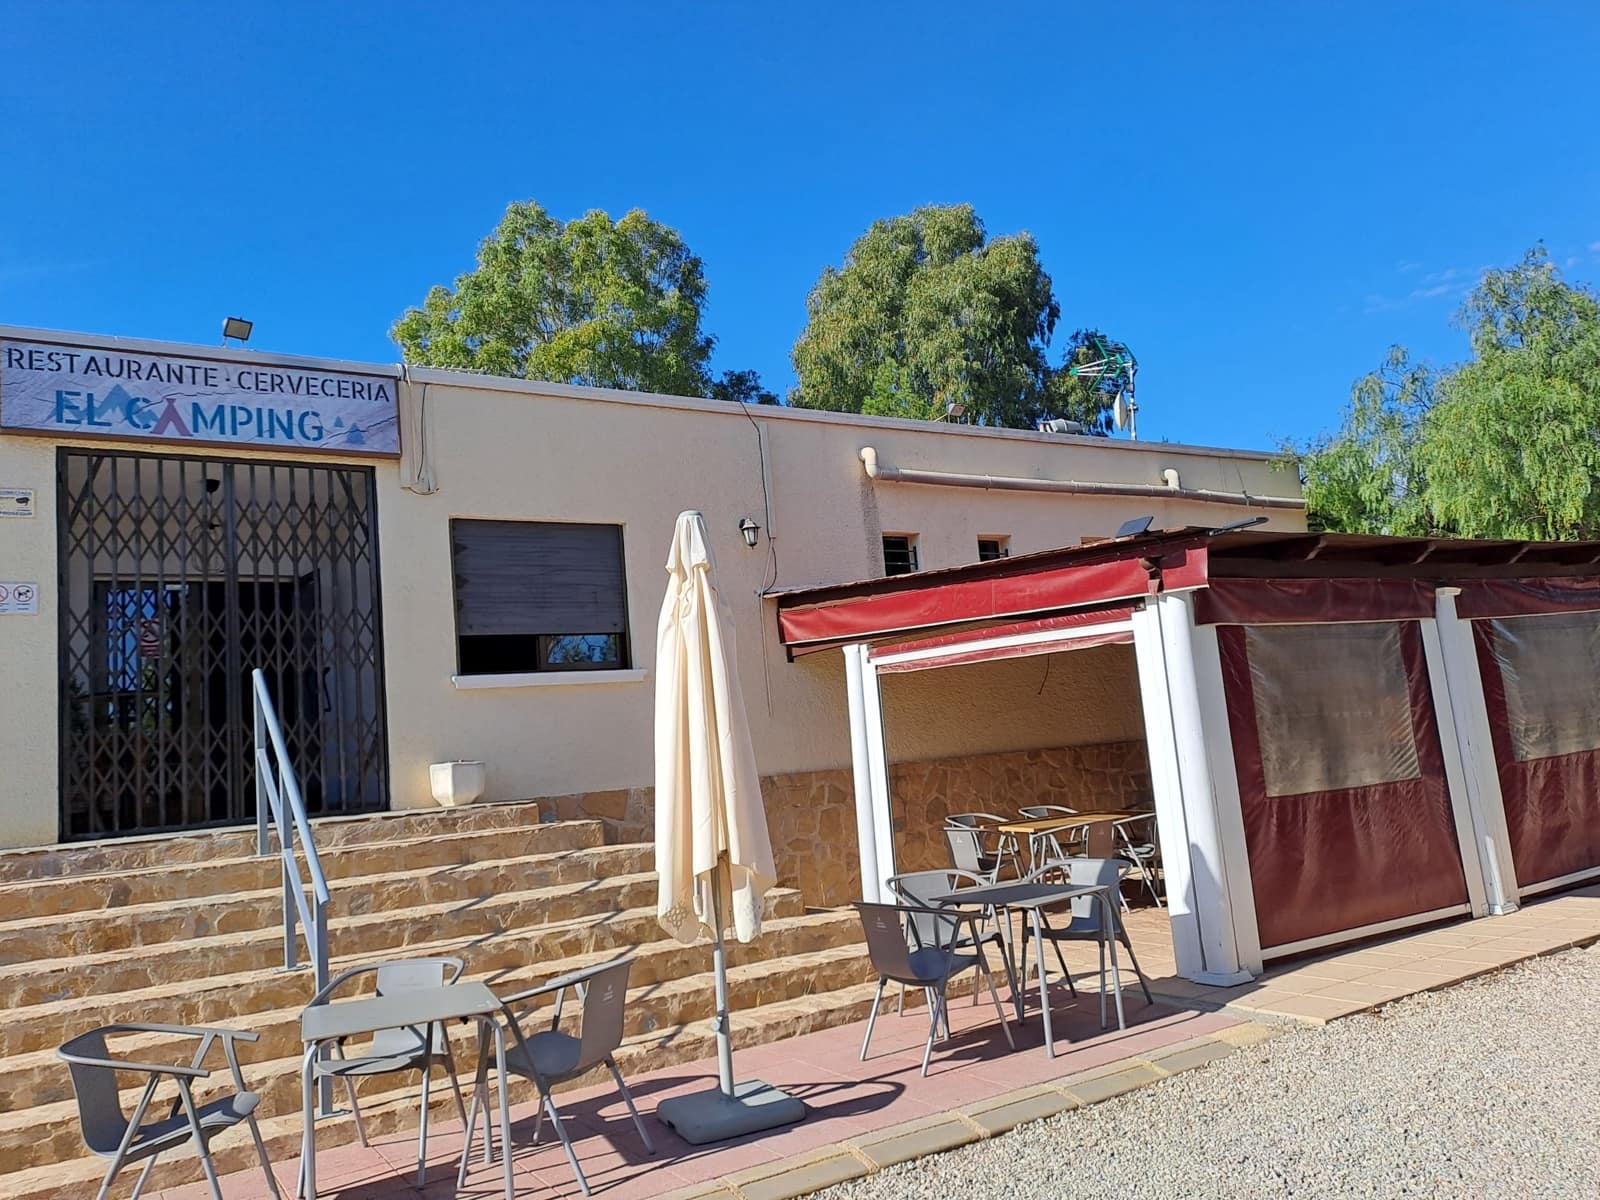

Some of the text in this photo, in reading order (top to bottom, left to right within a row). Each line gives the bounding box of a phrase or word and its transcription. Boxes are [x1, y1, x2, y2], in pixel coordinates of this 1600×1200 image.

[7, 347, 390, 402] RESTAURANTE CERVECERIA
[56, 390, 324, 442] EL CAMPING
